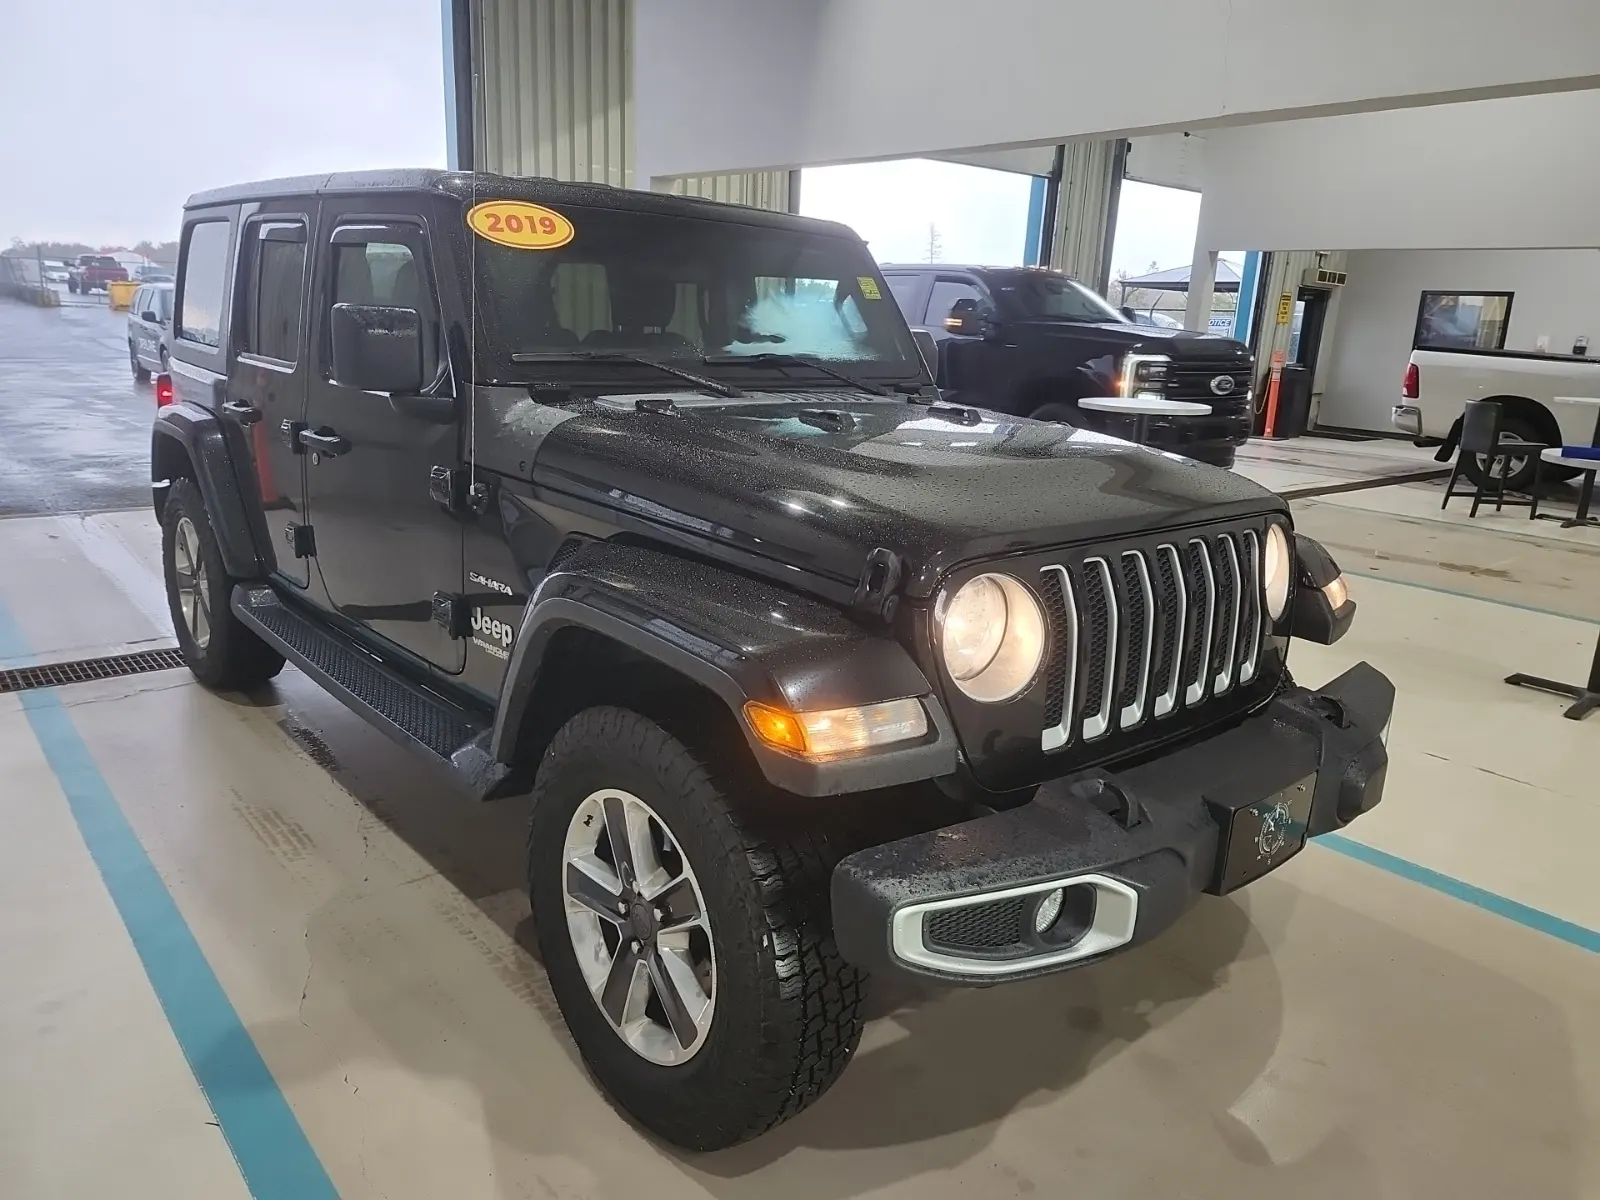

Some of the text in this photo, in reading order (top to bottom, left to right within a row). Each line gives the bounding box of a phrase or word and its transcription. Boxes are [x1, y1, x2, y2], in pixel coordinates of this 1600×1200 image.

[484, 213, 557, 235] 2019
[469, 572, 513, 595] SAHARA
[471, 607, 513, 647] Jeep
[472, 636, 510, 657] WRANGLE
